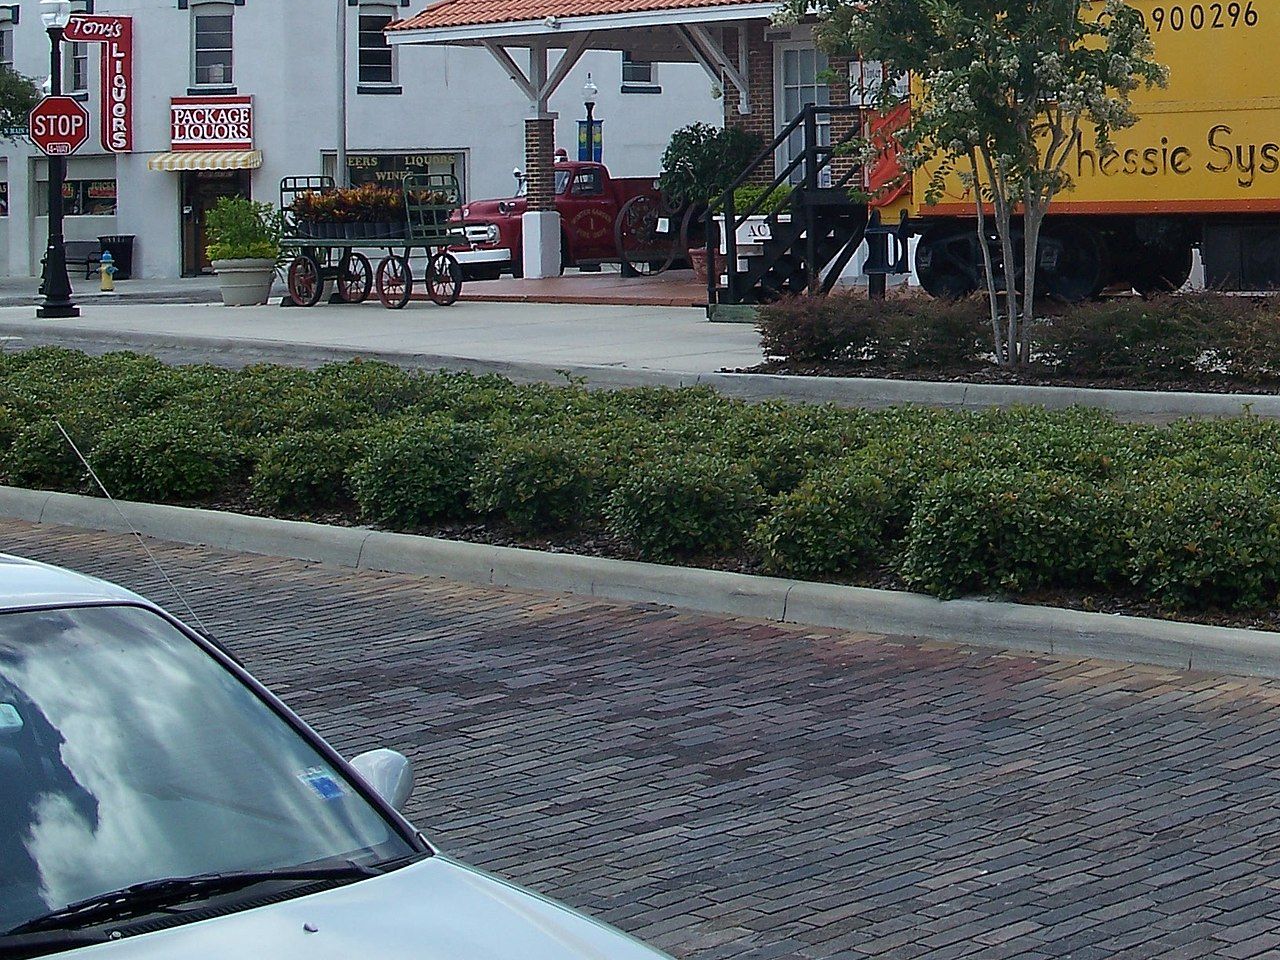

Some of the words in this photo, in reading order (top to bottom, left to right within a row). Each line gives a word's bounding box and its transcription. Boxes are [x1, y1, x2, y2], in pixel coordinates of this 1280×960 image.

[1152, 0, 1258, 32] 900296
[70, 17, 123, 38] Tony's
[112, 43, 127, 148] LIQUORS
[34, 115, 83, 136] STOP
[174, 108, 250, 124] PACKAGE
[174, 124, 249, 139] LIQUORS
[346, 156, 378, 167] EERS
[405, 155, 455, 166] LIQUORS
